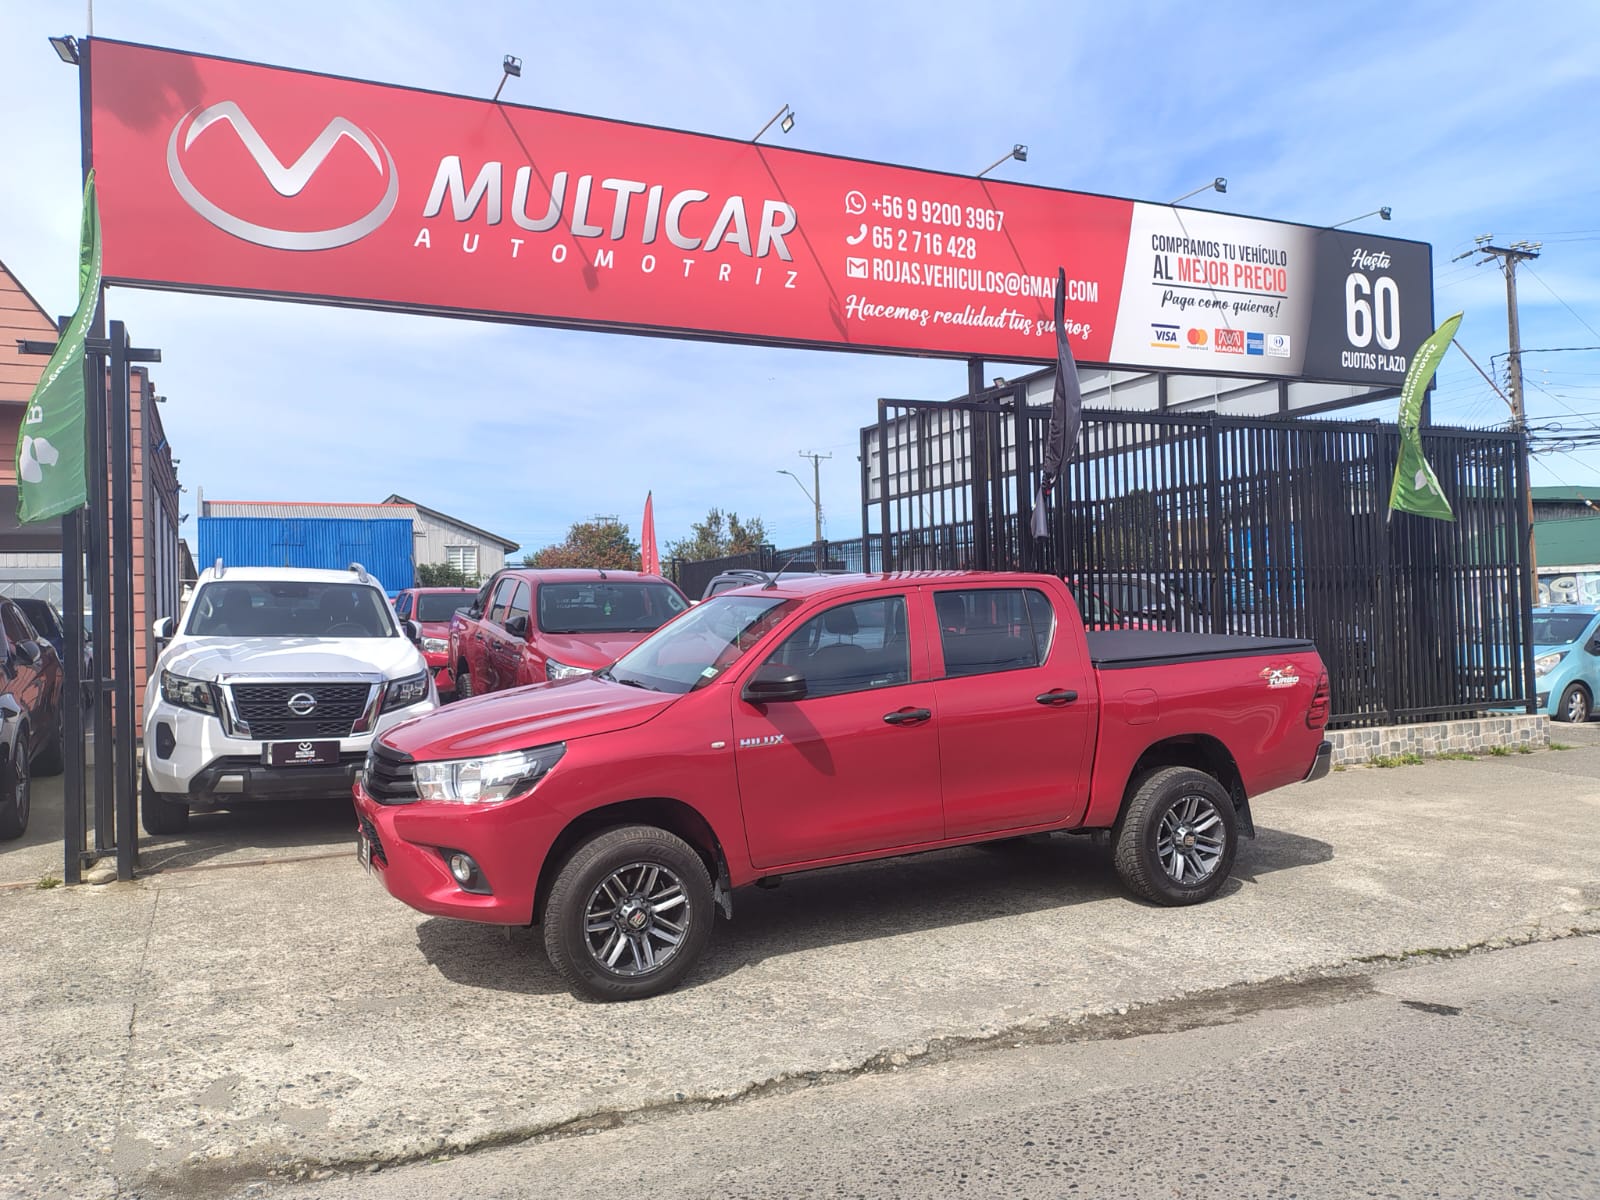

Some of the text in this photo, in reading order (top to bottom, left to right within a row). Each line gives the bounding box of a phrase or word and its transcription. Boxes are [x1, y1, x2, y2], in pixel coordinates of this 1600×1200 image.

[422, 155, 798, 263] MULTICAR
[872, 194, 1004, 232] +56 9 9200 3967
[413, 227, 799, 289] AUTOMOTRIZ
[872, 226, 977, 260] 65 2 716 428
[1152, 234, 1287, 267] COMPRAMOS TU VEHÍCULO
[1351, 248, 1392, 271] Hasta
[873, 258, 1099, 303] ROJAS.VEHICULOS@GMAI.COM
[1153, 254, 1287, 293] AL MEJOR PRECIO
[845, 294, 1093, 341] Hacemos realidad tus suños
[1161, 290, 1281, 318] Paga como quieras!
[1345, 272, 1401, 351] 60
[1155, 330, 1177, 342] VISA
[1215, 345, 1243, 354] MAGNA
[1341, 351, 1406, 373] CUOTAS PLAZO
